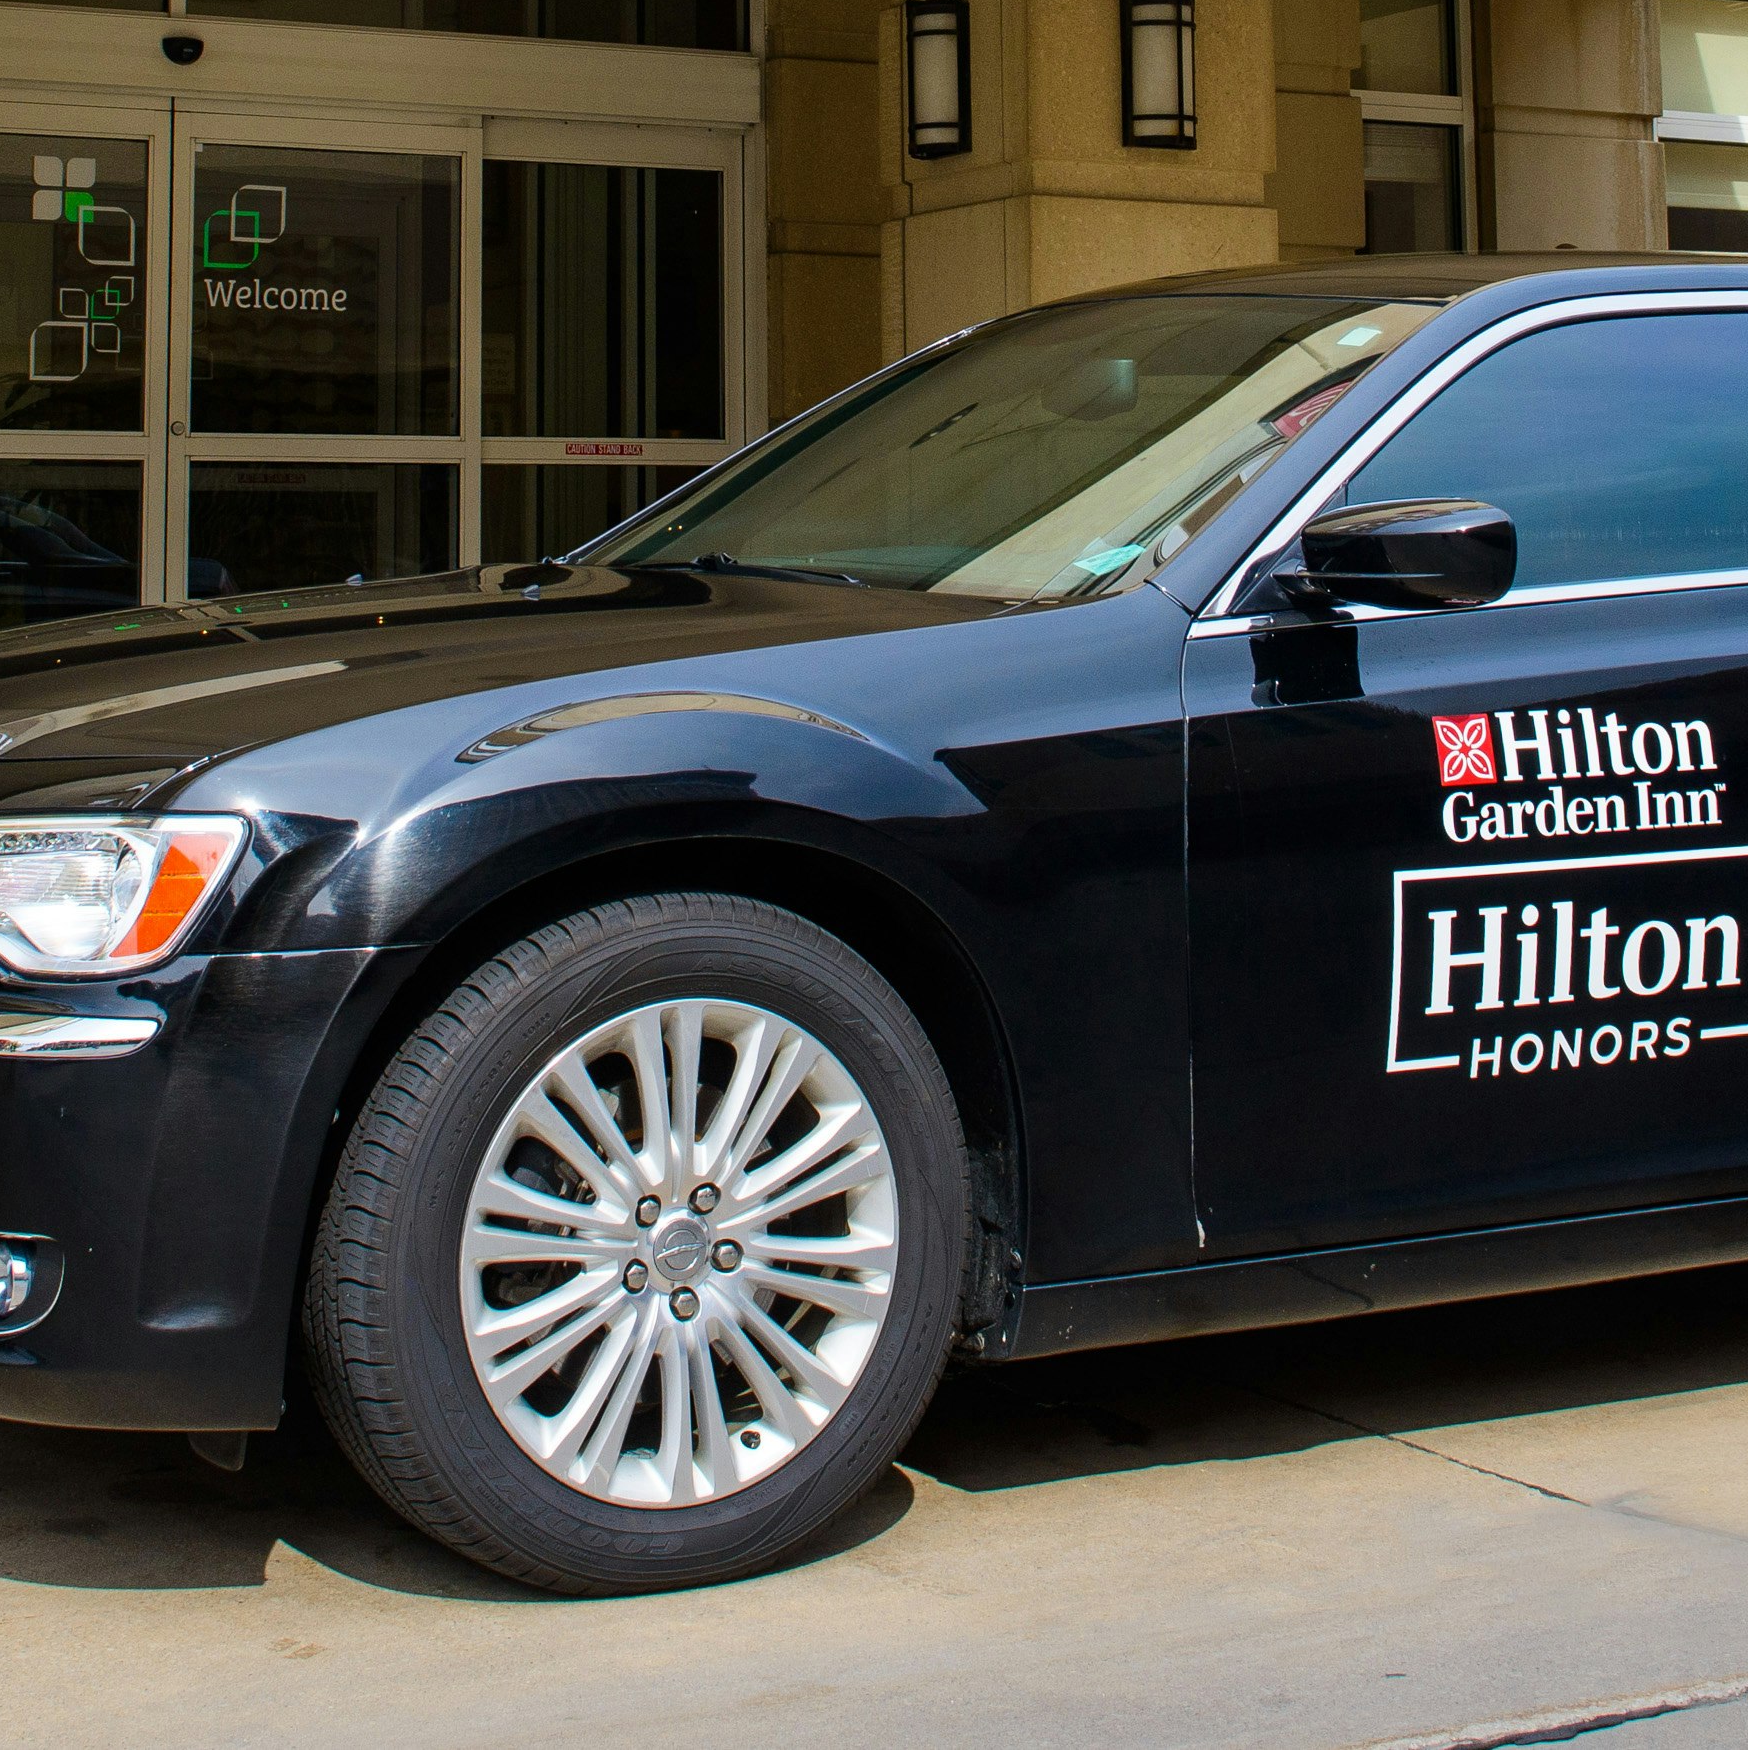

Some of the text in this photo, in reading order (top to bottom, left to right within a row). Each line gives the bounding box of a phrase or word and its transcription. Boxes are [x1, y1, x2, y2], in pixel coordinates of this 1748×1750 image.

[204, 278, 347, 312] Welcome
[567, 443, 641, 455] CAUTION STAND BACK
[1494, 707, 1718, 783] Hilton
[1442, 785, 1630, 843] Garden
[1424, 900, 1741, 1015] Hilton
[1469, 1017, 1692, 1079] HONORS
